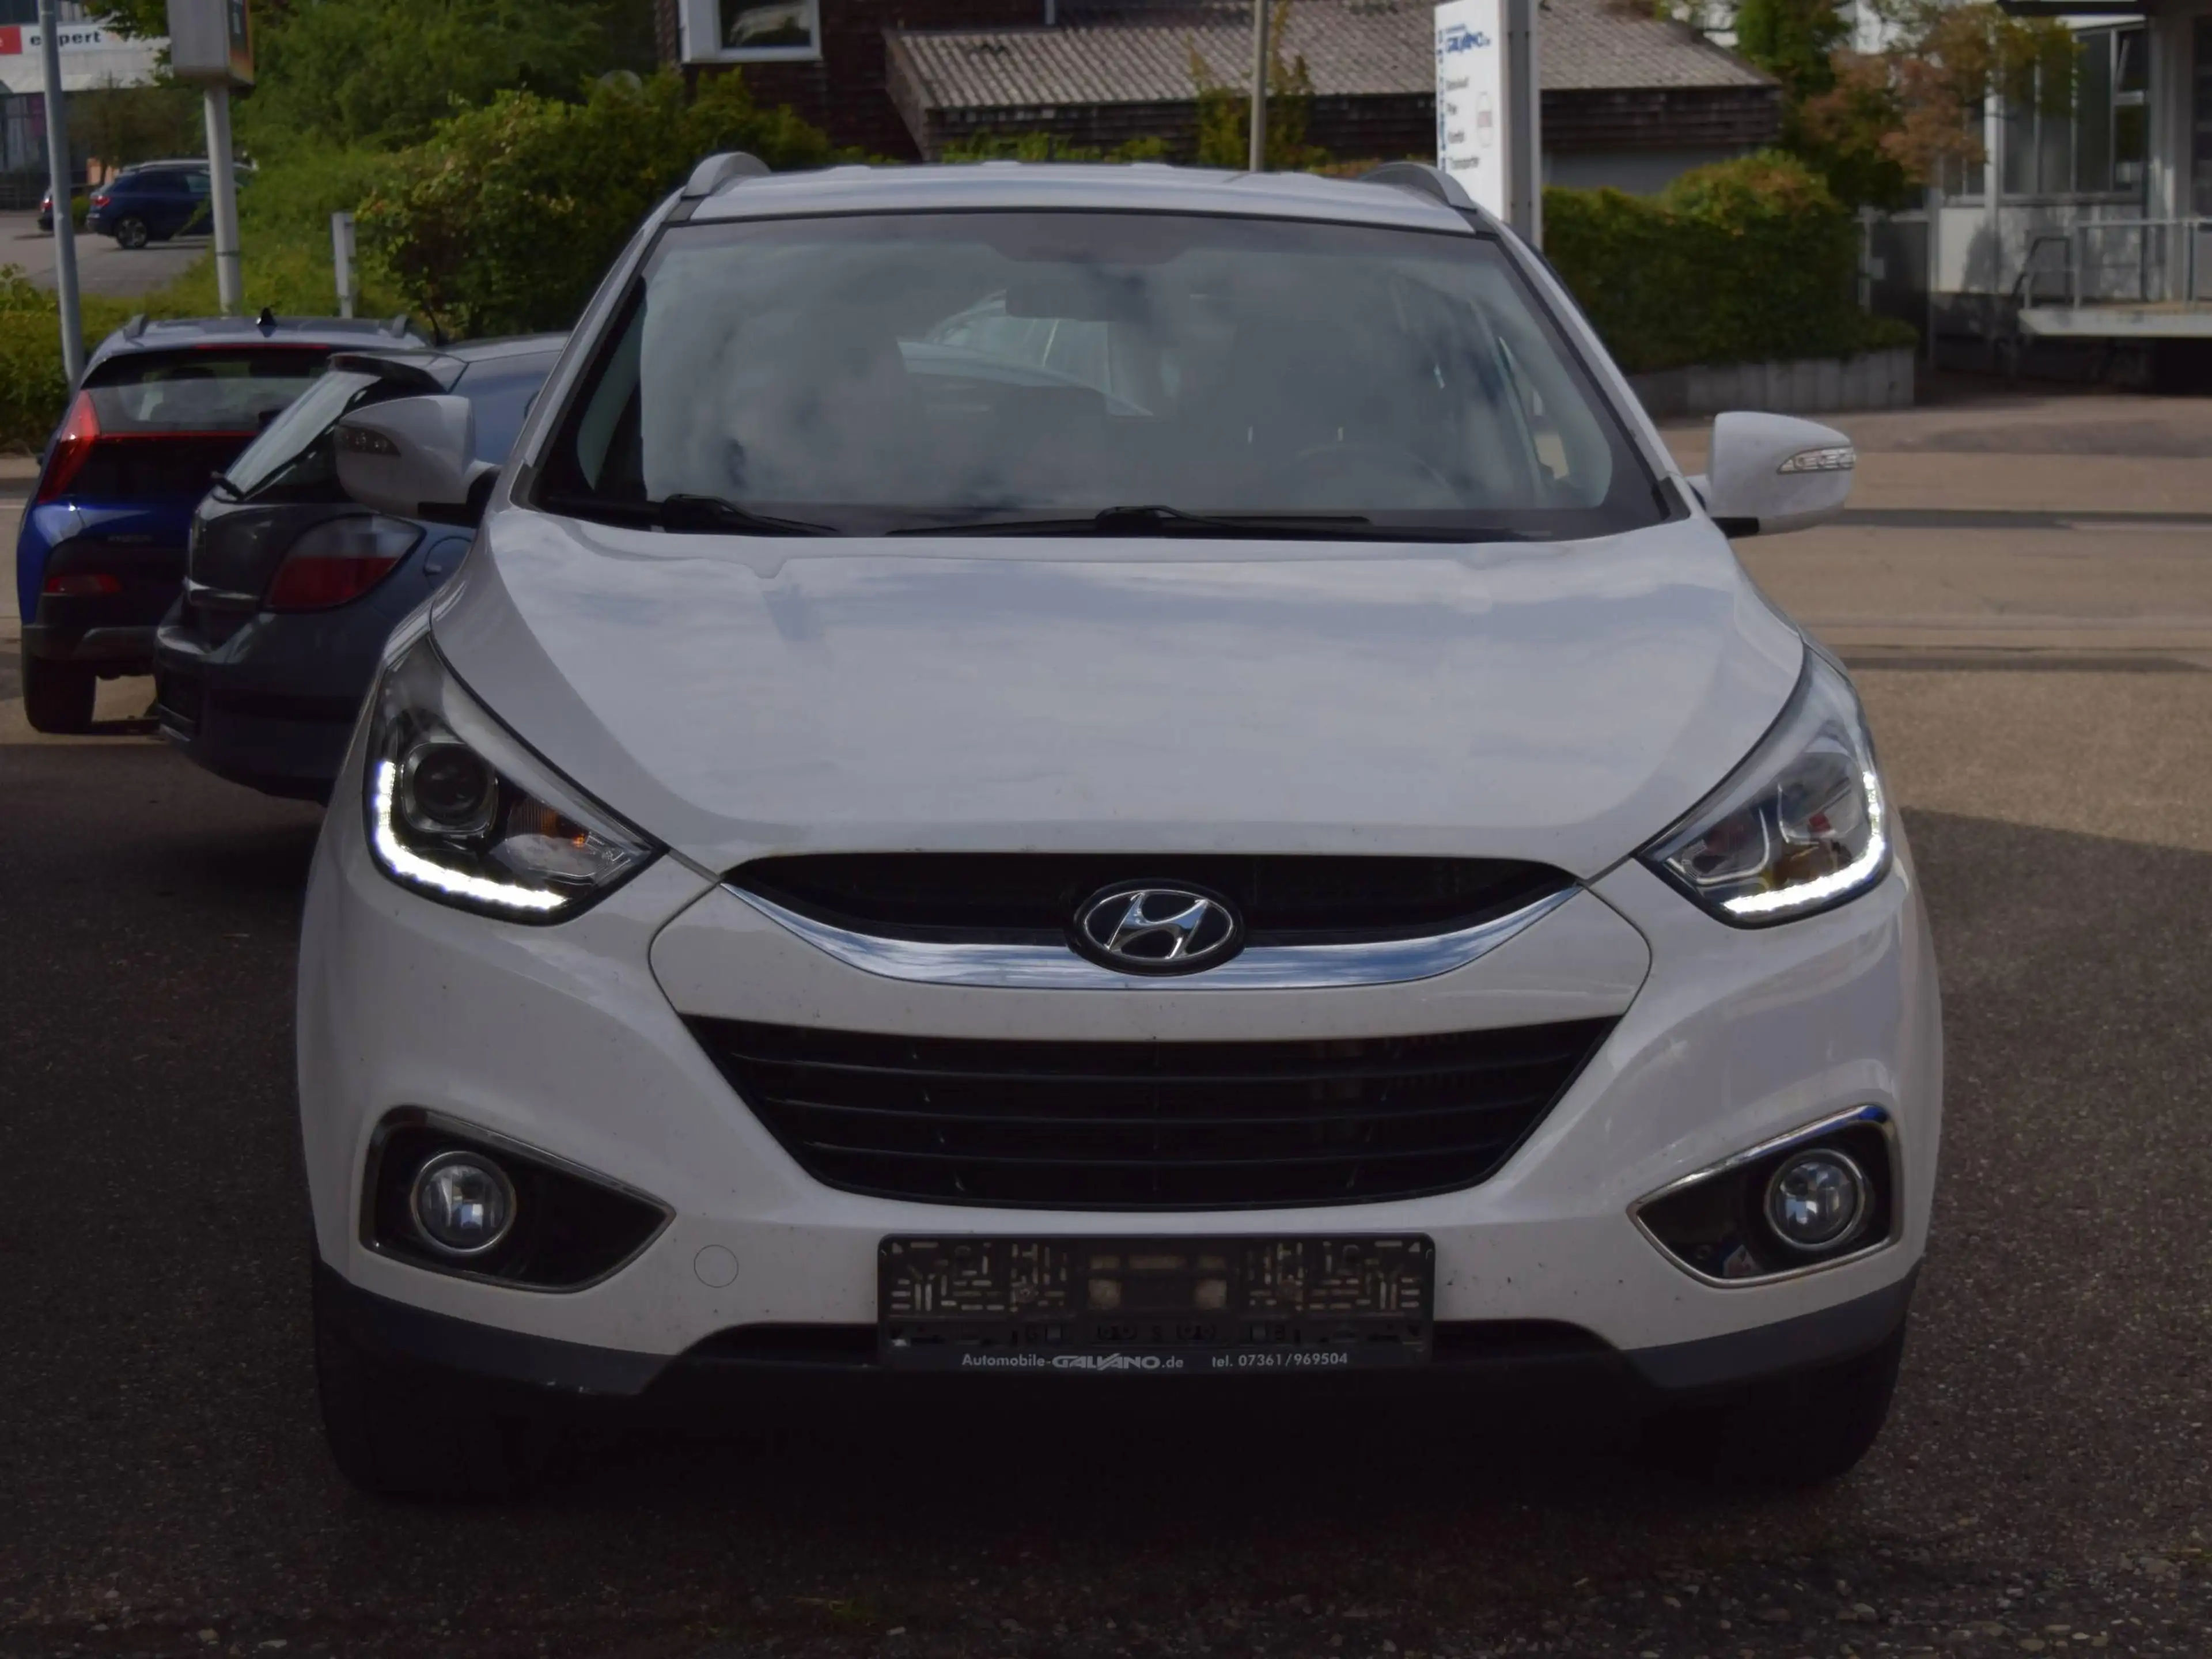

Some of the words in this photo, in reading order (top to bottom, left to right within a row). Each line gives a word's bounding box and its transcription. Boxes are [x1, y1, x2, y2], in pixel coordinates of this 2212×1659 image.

[30, 31, 101, 47] epert
[1212, 1355, 1233, 1368] tel.
[1238, 1352, 1349, 1368] 07361/969504
